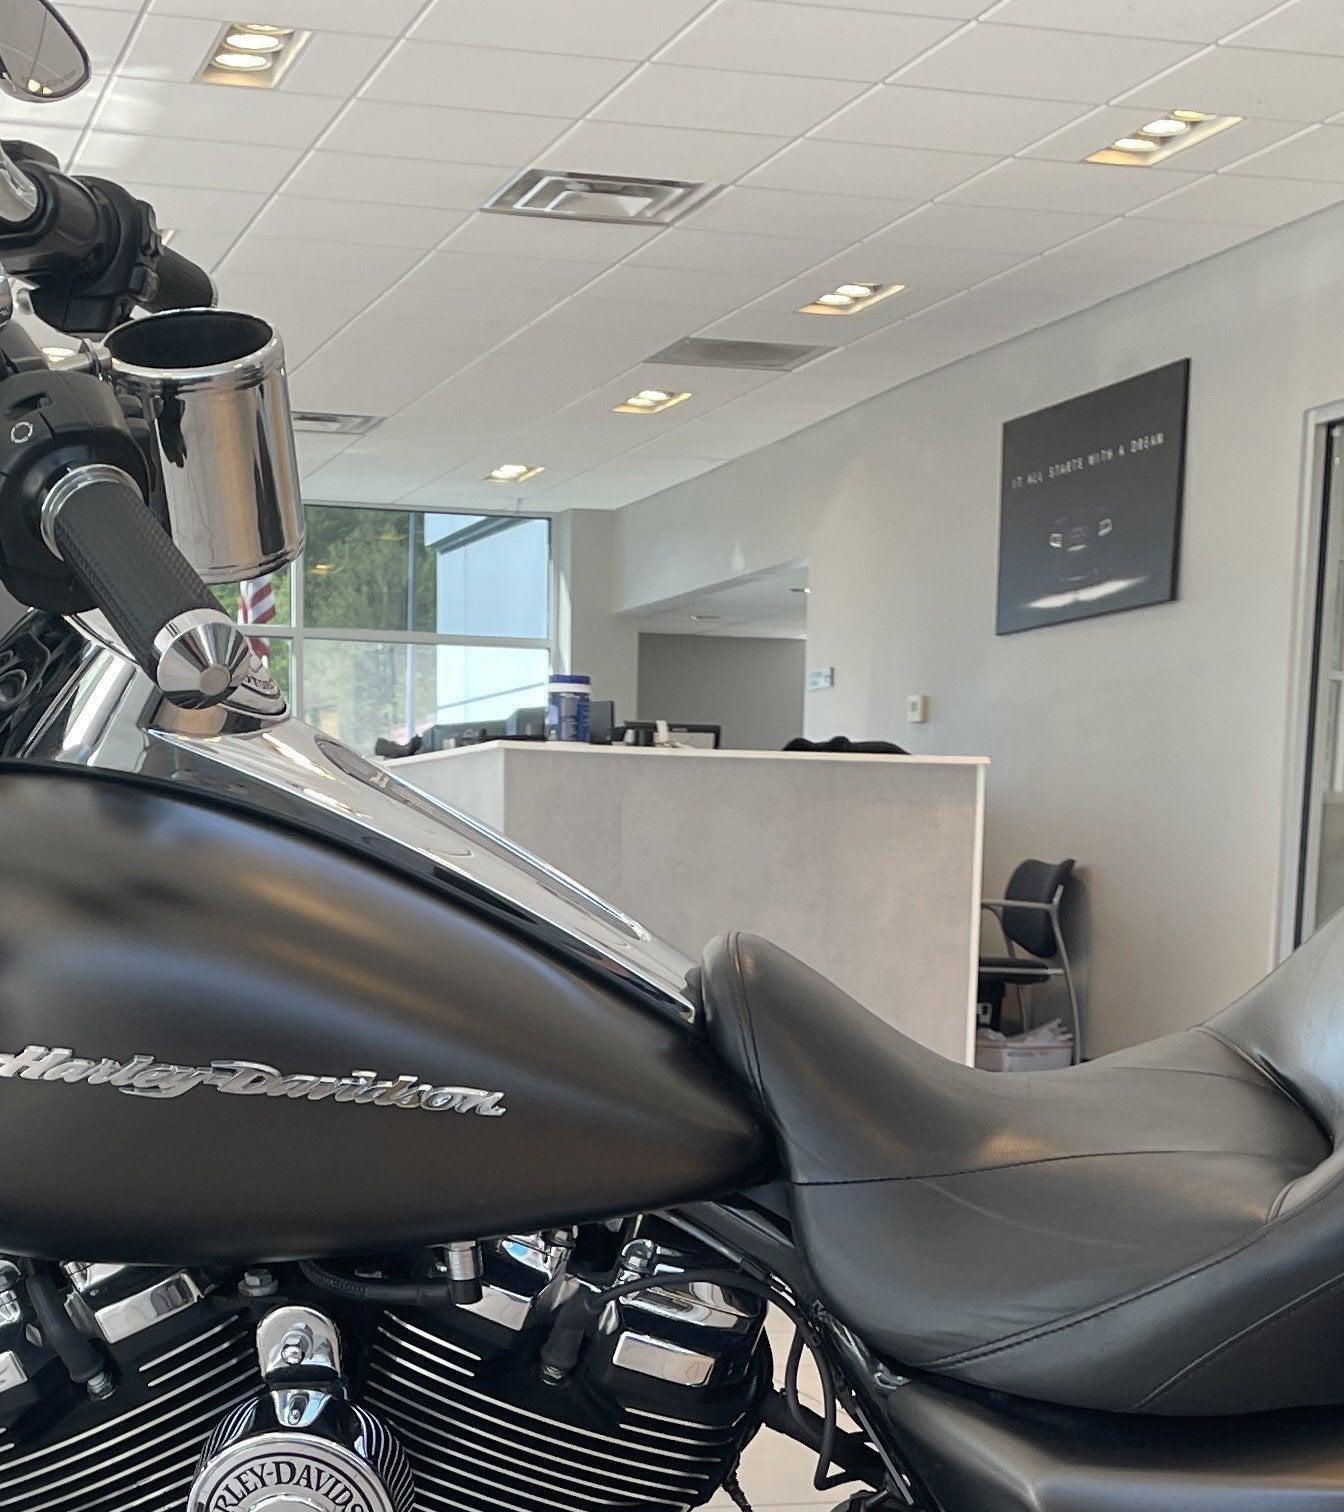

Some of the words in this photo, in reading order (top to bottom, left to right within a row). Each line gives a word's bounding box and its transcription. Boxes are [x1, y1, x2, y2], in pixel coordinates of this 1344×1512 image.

[1049, 457, 1083, 478] STARTS
[1088, 449, 1113, 466] WITH
[1130, 432, 1164, 453] DREAM
